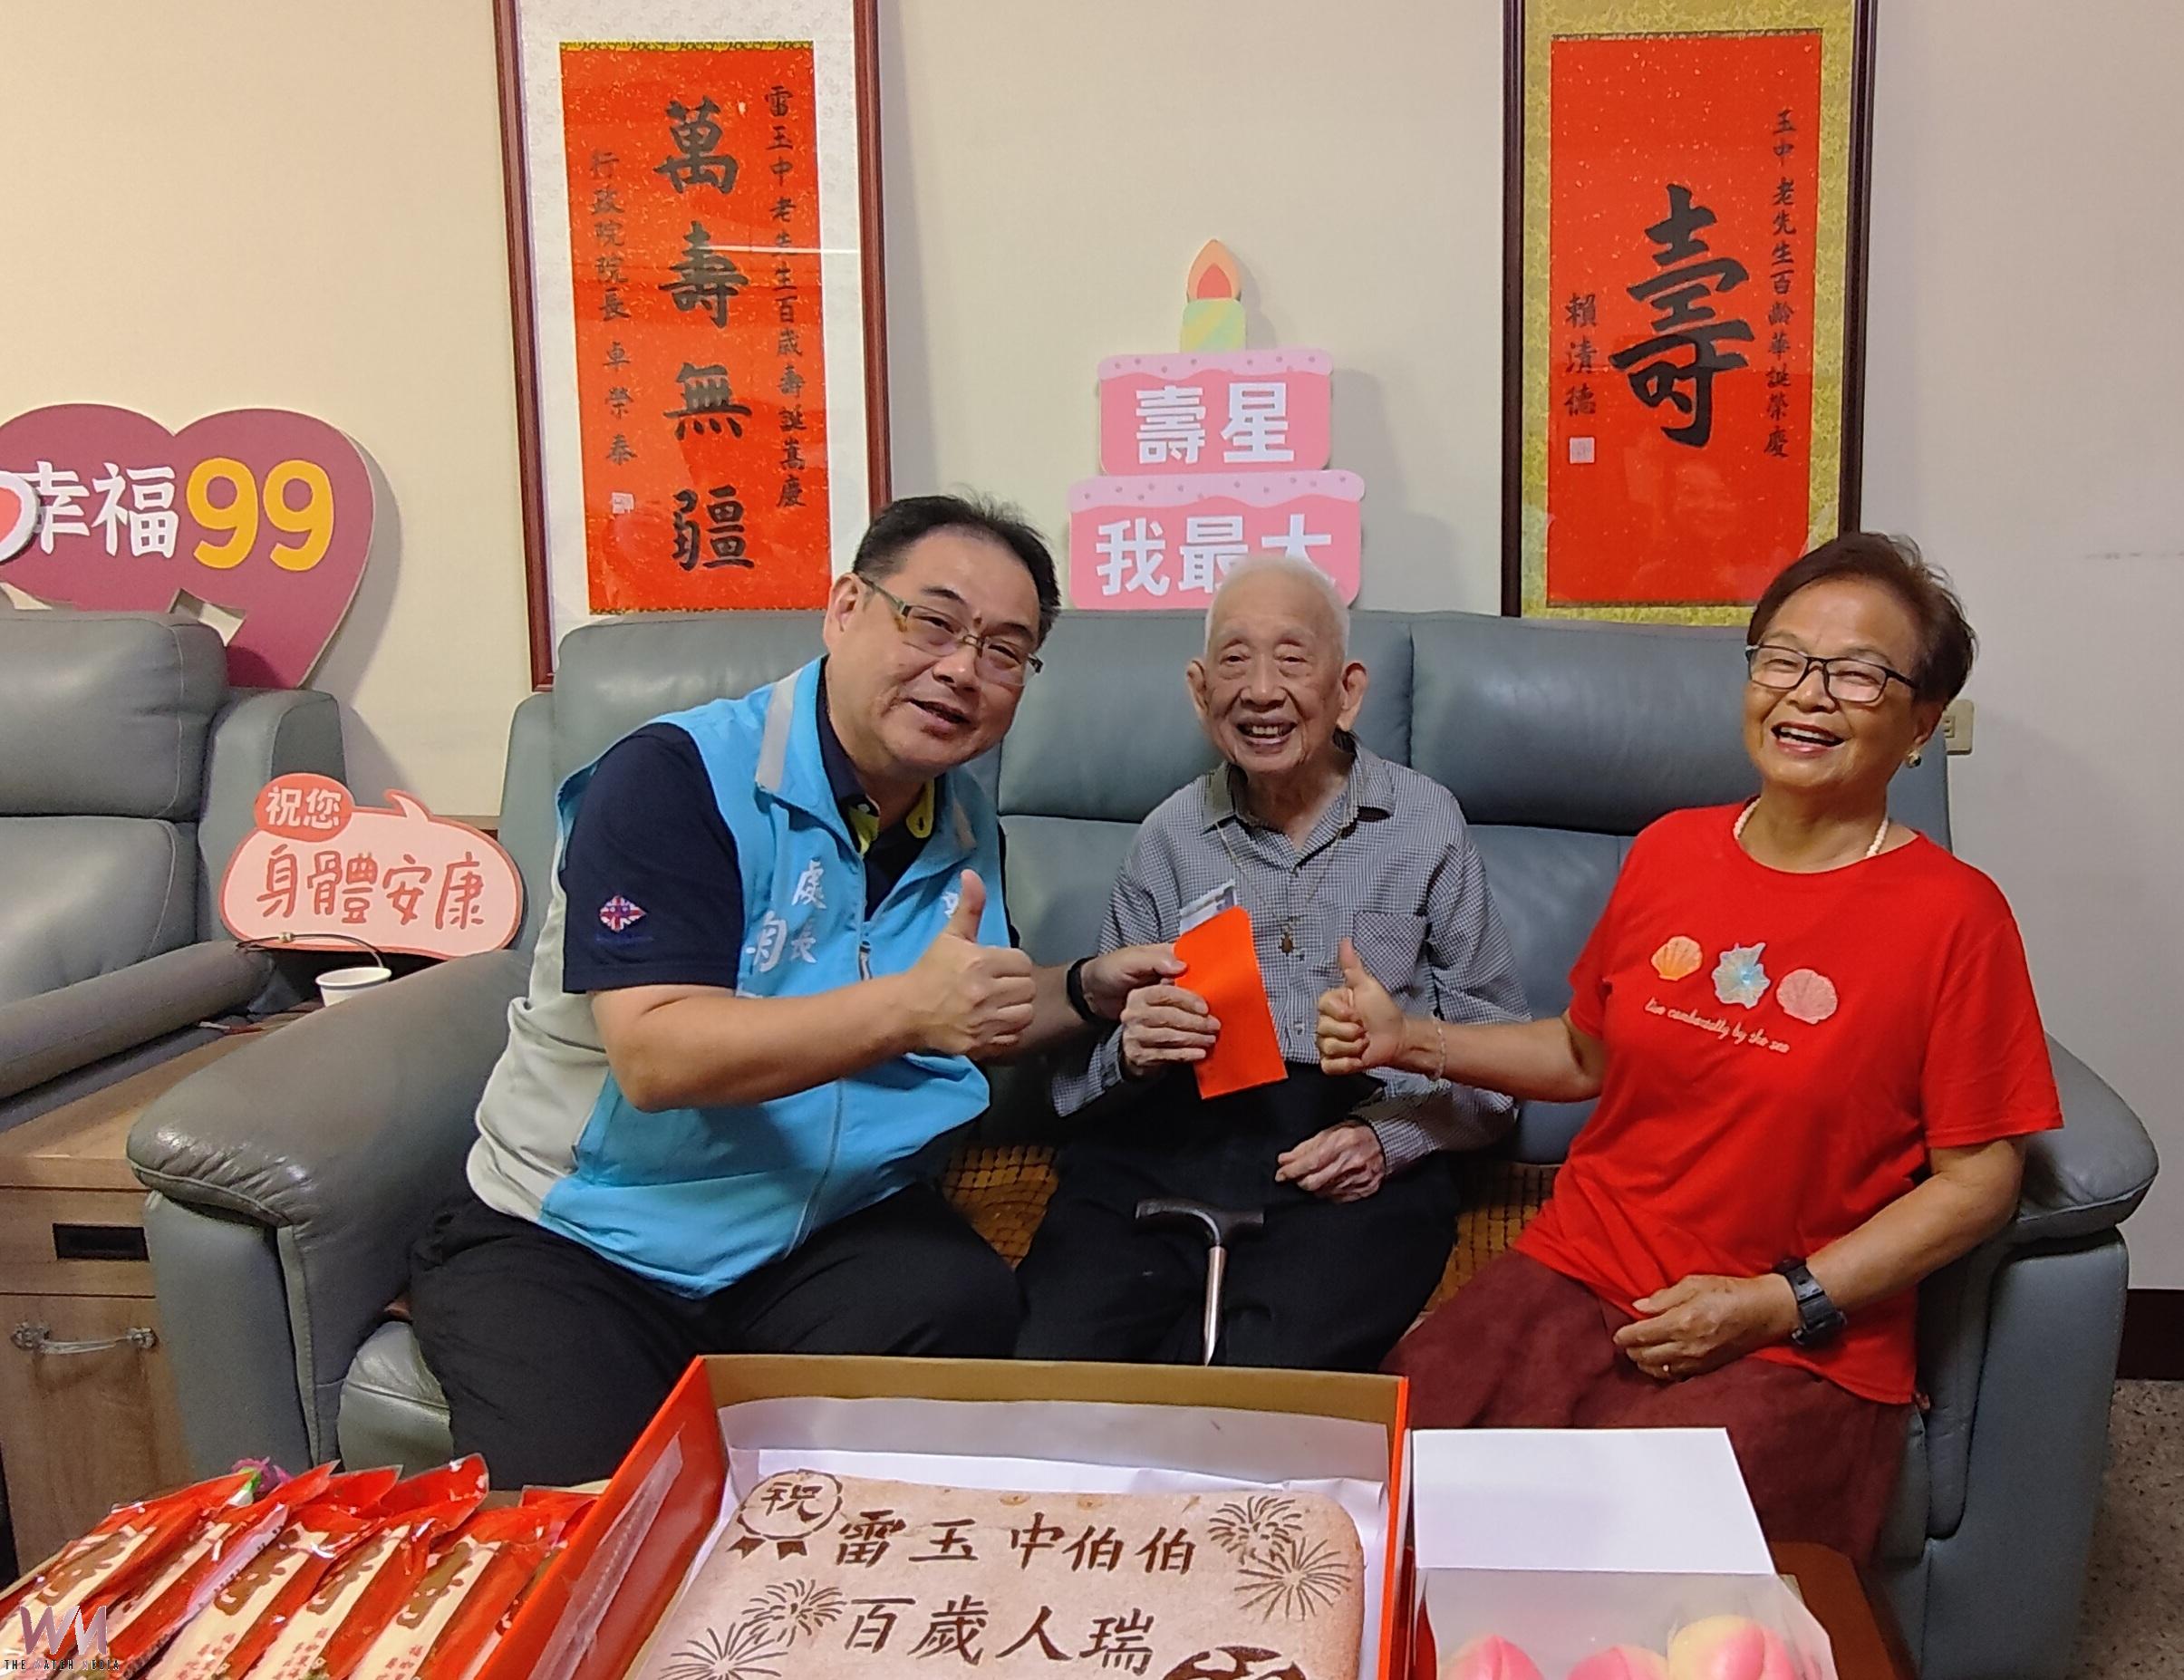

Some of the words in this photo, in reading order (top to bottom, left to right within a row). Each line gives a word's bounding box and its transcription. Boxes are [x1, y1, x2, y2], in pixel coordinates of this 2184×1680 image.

[590, 150, 633, 322] 行政院院長
[653, 95, 755, 570] 萬壽無疆
[1564, 293, 1598, 417] 賴清德
[1609, 183, 1756, 449] 壽
[603, 342, 638, 467] 卓榮泰
[1135, 382, 1295, 465] 壽星
[266, 786, 342, 829] 祝您
[256, 844, 485, 931] 身體安康
[1732, 1021, 1747, 1045] by
[760, 1481, 826, 1524] 祝
[836, 1509, 1197, 1577] 雷玉中伯伯
[843, 1595, 1156, 1677] 百歲人瑞
